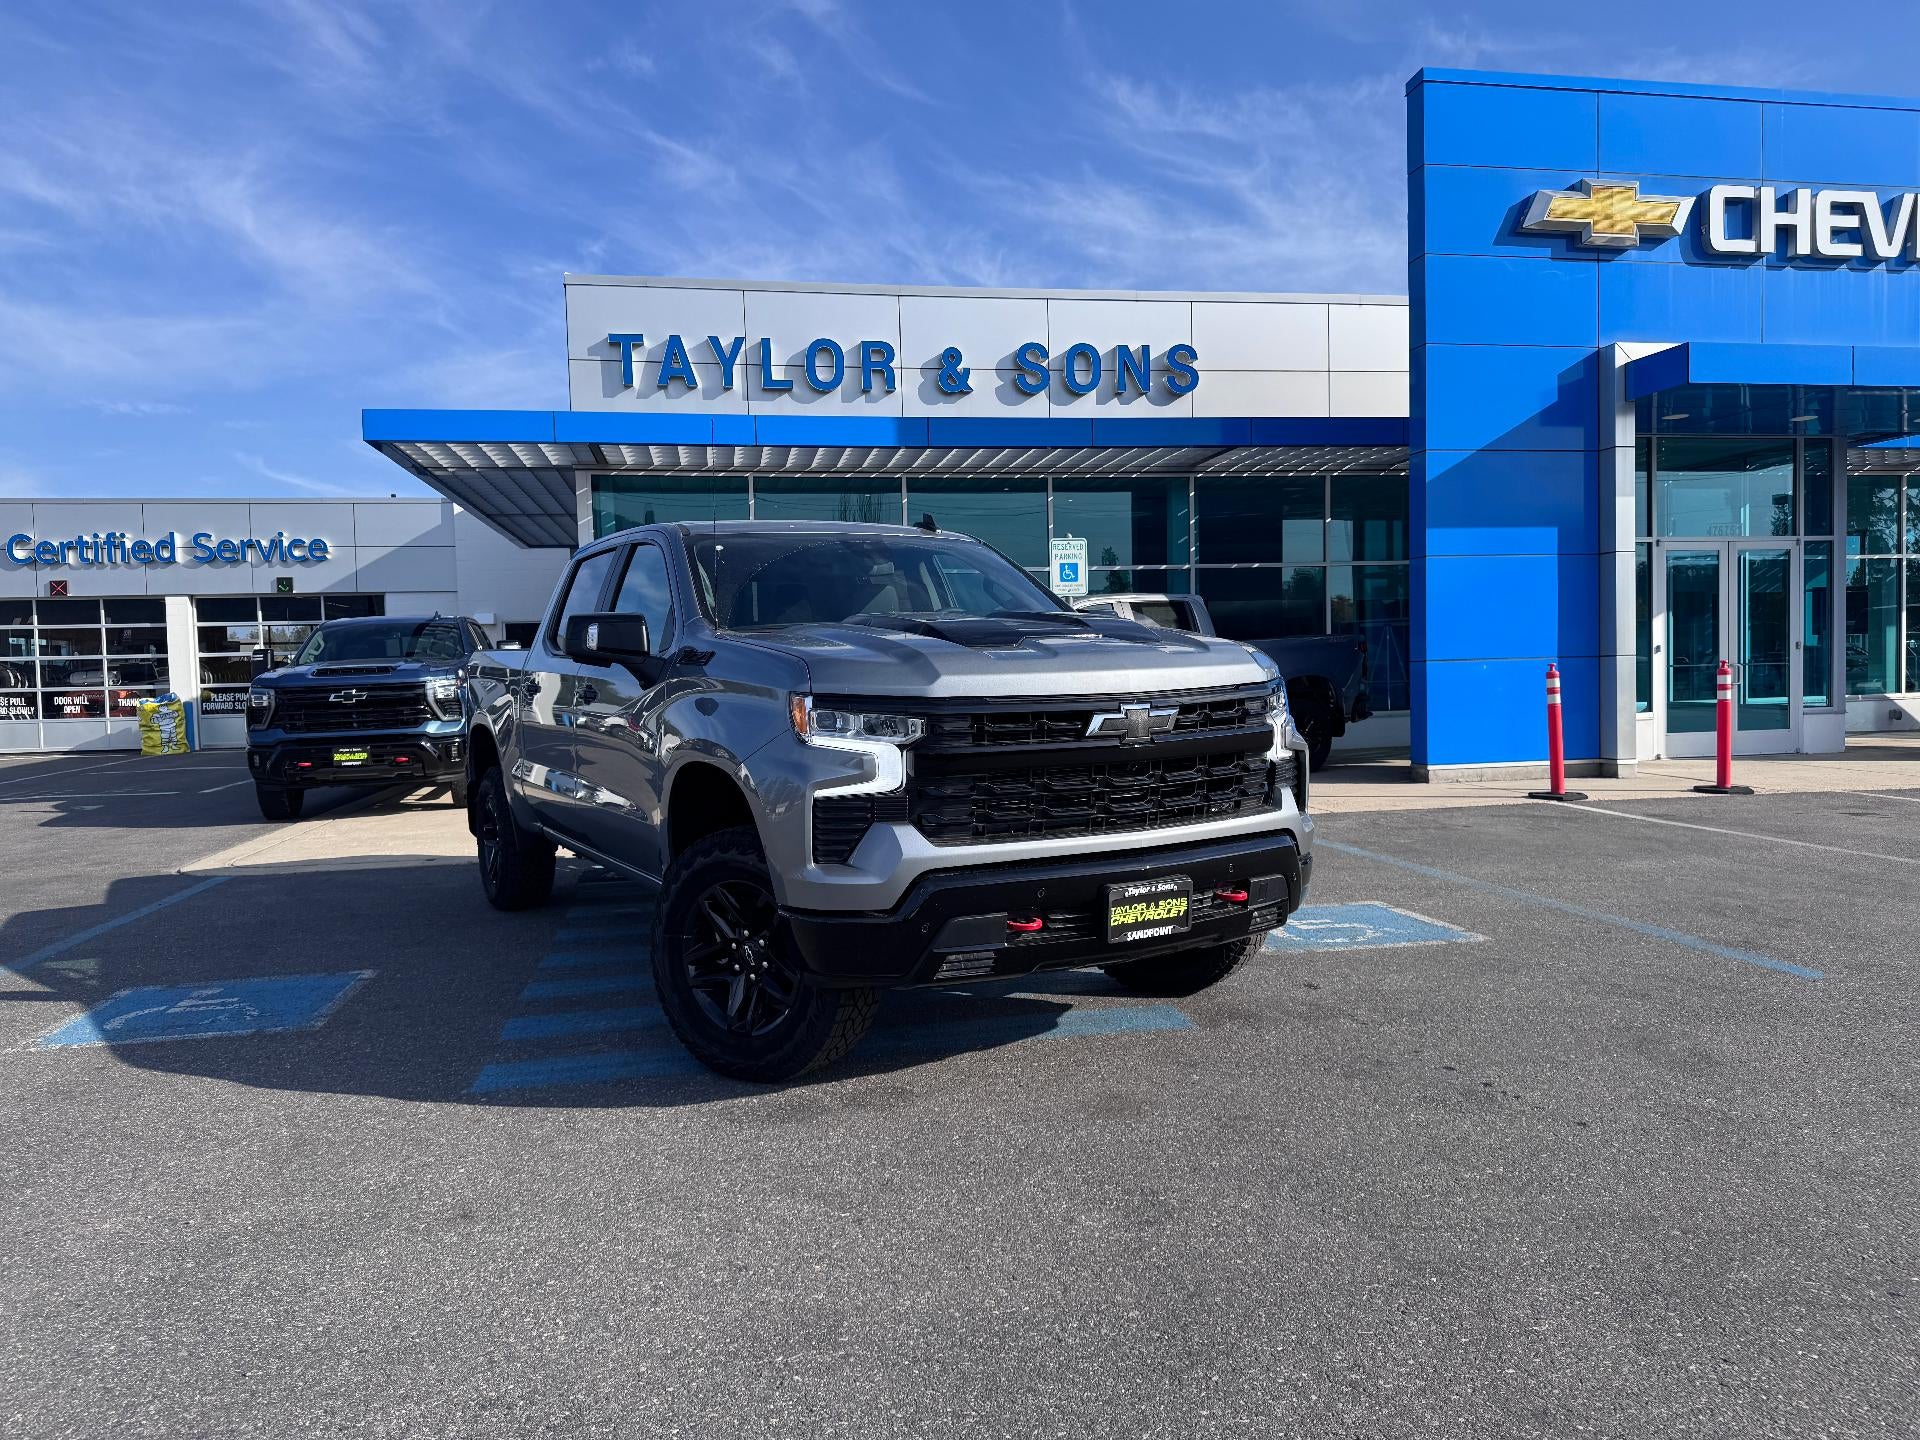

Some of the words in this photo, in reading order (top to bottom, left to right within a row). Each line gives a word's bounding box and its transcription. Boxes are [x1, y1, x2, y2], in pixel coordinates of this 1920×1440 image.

[1709, 184, 1920, 259] CHEV
[607, 333, 897, 392] TAYLOR
[937, 346, 974, 394] &
[1014, 341, 1200, 394] SONS
[6, 531, 176, 564] Certified
[192, 531, 329, 562] Service
[1053, 543, 1084, 551] RESERVED
[10, 697, 26, 706] PULL
[54, 697, 72, 705] DOOR
[73, 696, 90, 705] WILL
[211, 693, 235, 701] PLEASE
[9, 706, 35, 715] SLOWLY
[63, 705, 80, 713] OPEN
[203, 702, 234, 710] FORWARD
[235, 702, 246, 710] SLO
[1127, 886, 1151, 897] Taylor
[1157, 883, 1175, 892] Sons
[1111, 902, 1147, 915] TAYLOR
[1149, 902, 1156, 911] &
[1158, 898, 1188, 908] SONS
[1111, 906, 1187, 926] CHEVROLET
[1126, 925, 1174, 941] SANDPOINT
